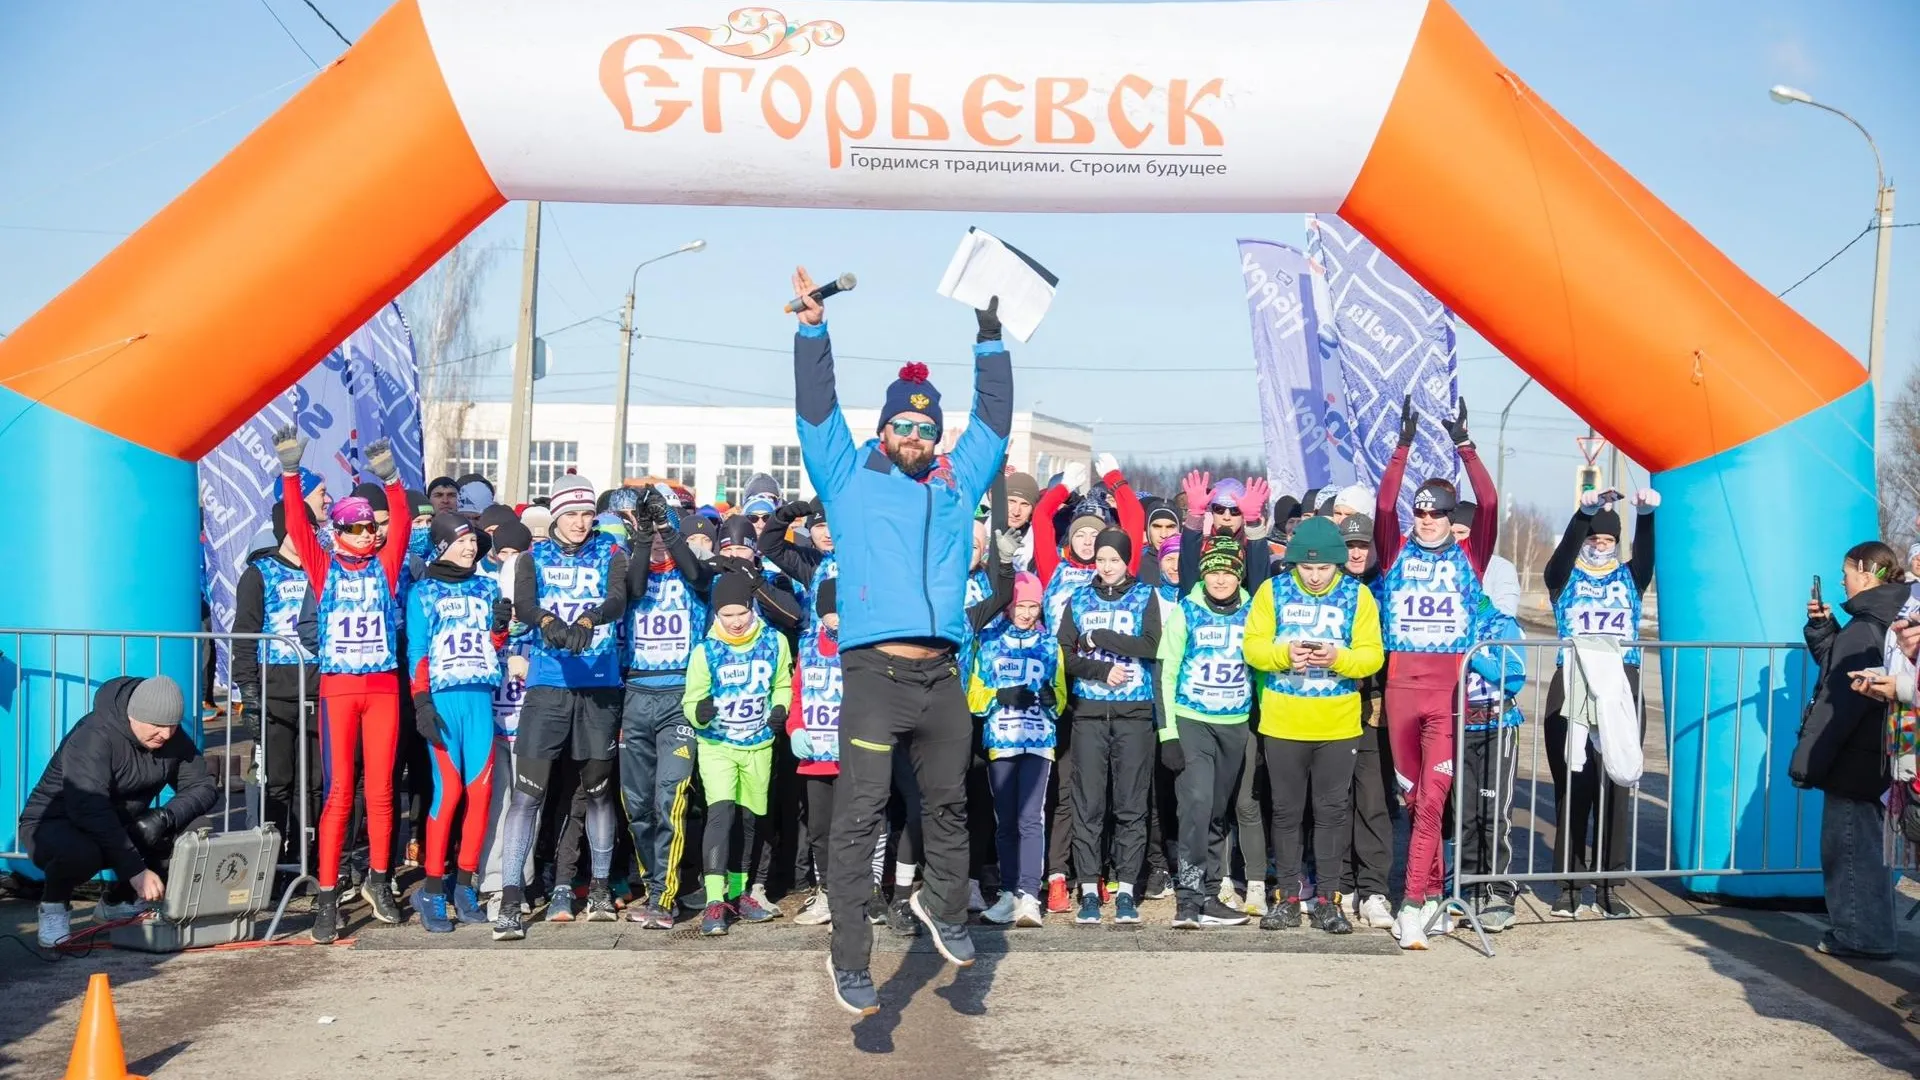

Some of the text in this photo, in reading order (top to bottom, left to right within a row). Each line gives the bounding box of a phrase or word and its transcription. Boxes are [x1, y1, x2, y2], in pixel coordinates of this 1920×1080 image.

[850, 153, 1227, 177] Гордимся традициями. Строим будущее
[1404, 595, 1454, 617] 184
[338, 616, 381, 638] 151
[639, 614, 682, 635] 180
[1579, 611, 1625, 630] 174
[1200, 663, 1245, 684] 152
[803, 705, 840, 726] 162
